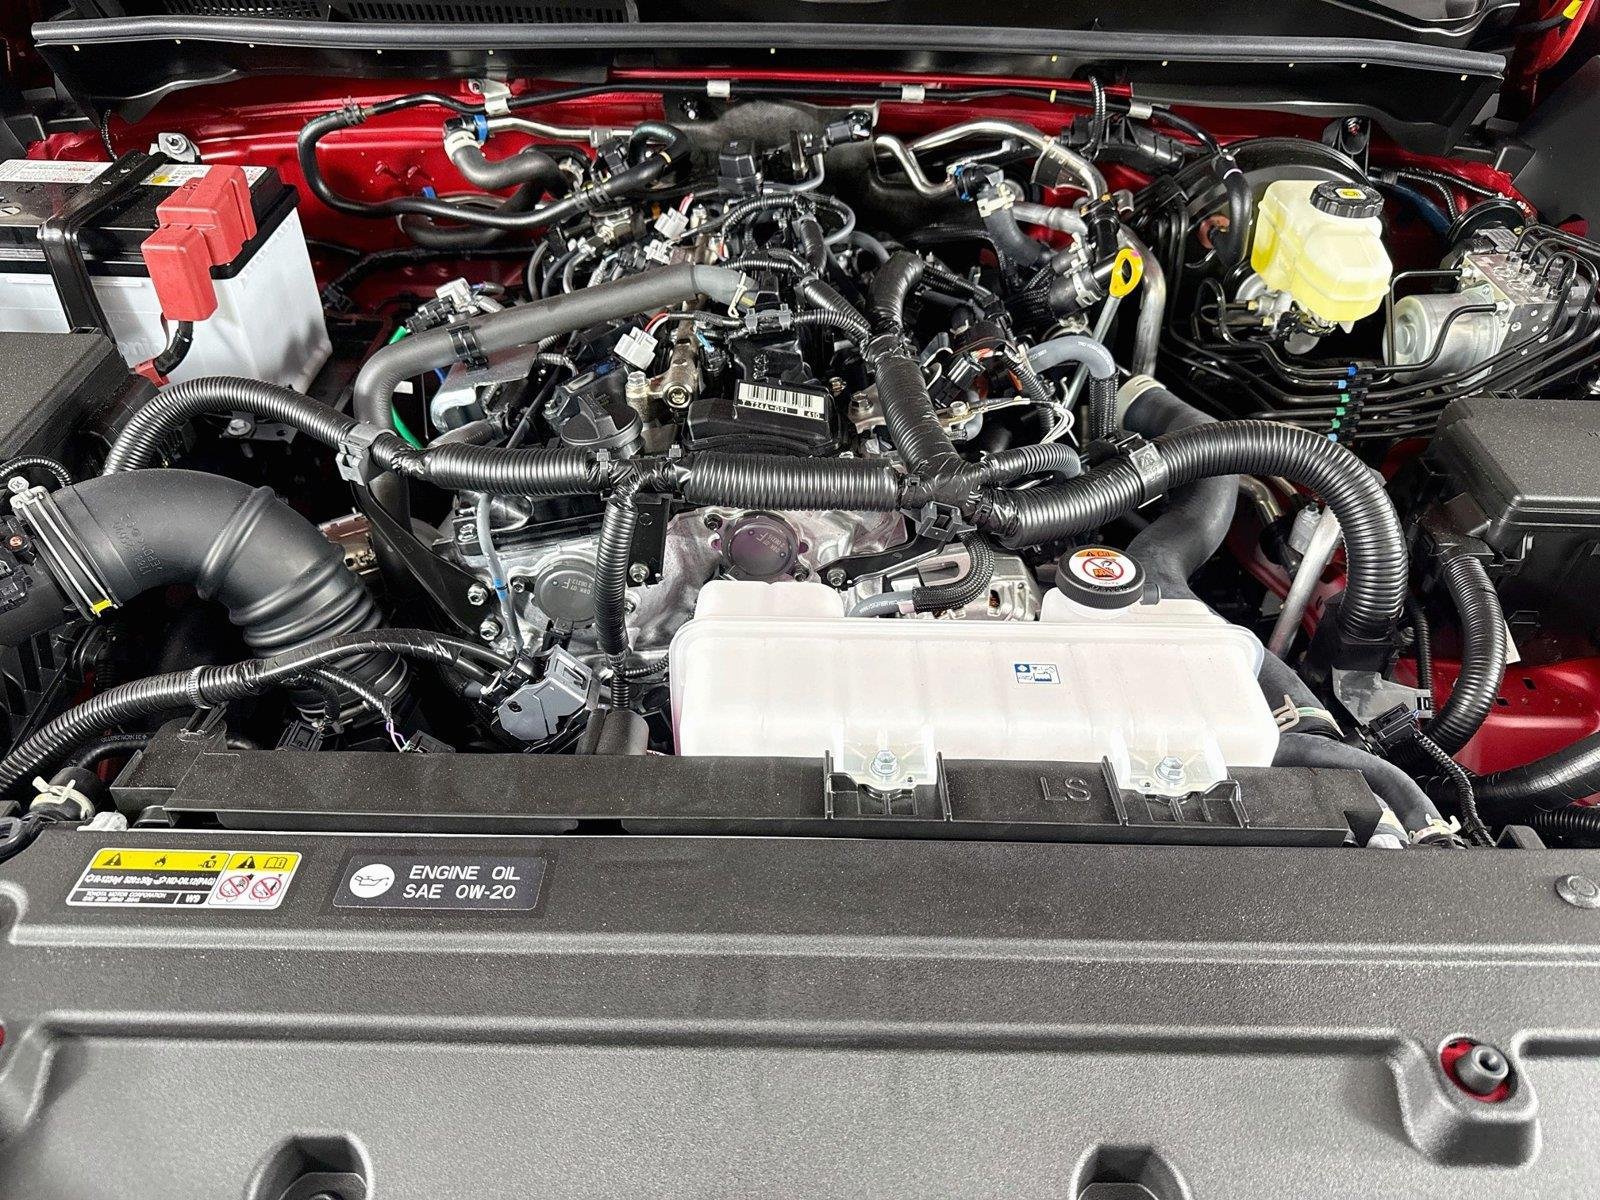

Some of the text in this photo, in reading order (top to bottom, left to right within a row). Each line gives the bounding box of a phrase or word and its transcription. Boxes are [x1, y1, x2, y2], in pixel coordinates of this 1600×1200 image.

[1040, 776, 1091, 801] LS
[408, 865, 521, 881] ENGINE OIL
[402, 884, 517, 900] SAE 0W-20
